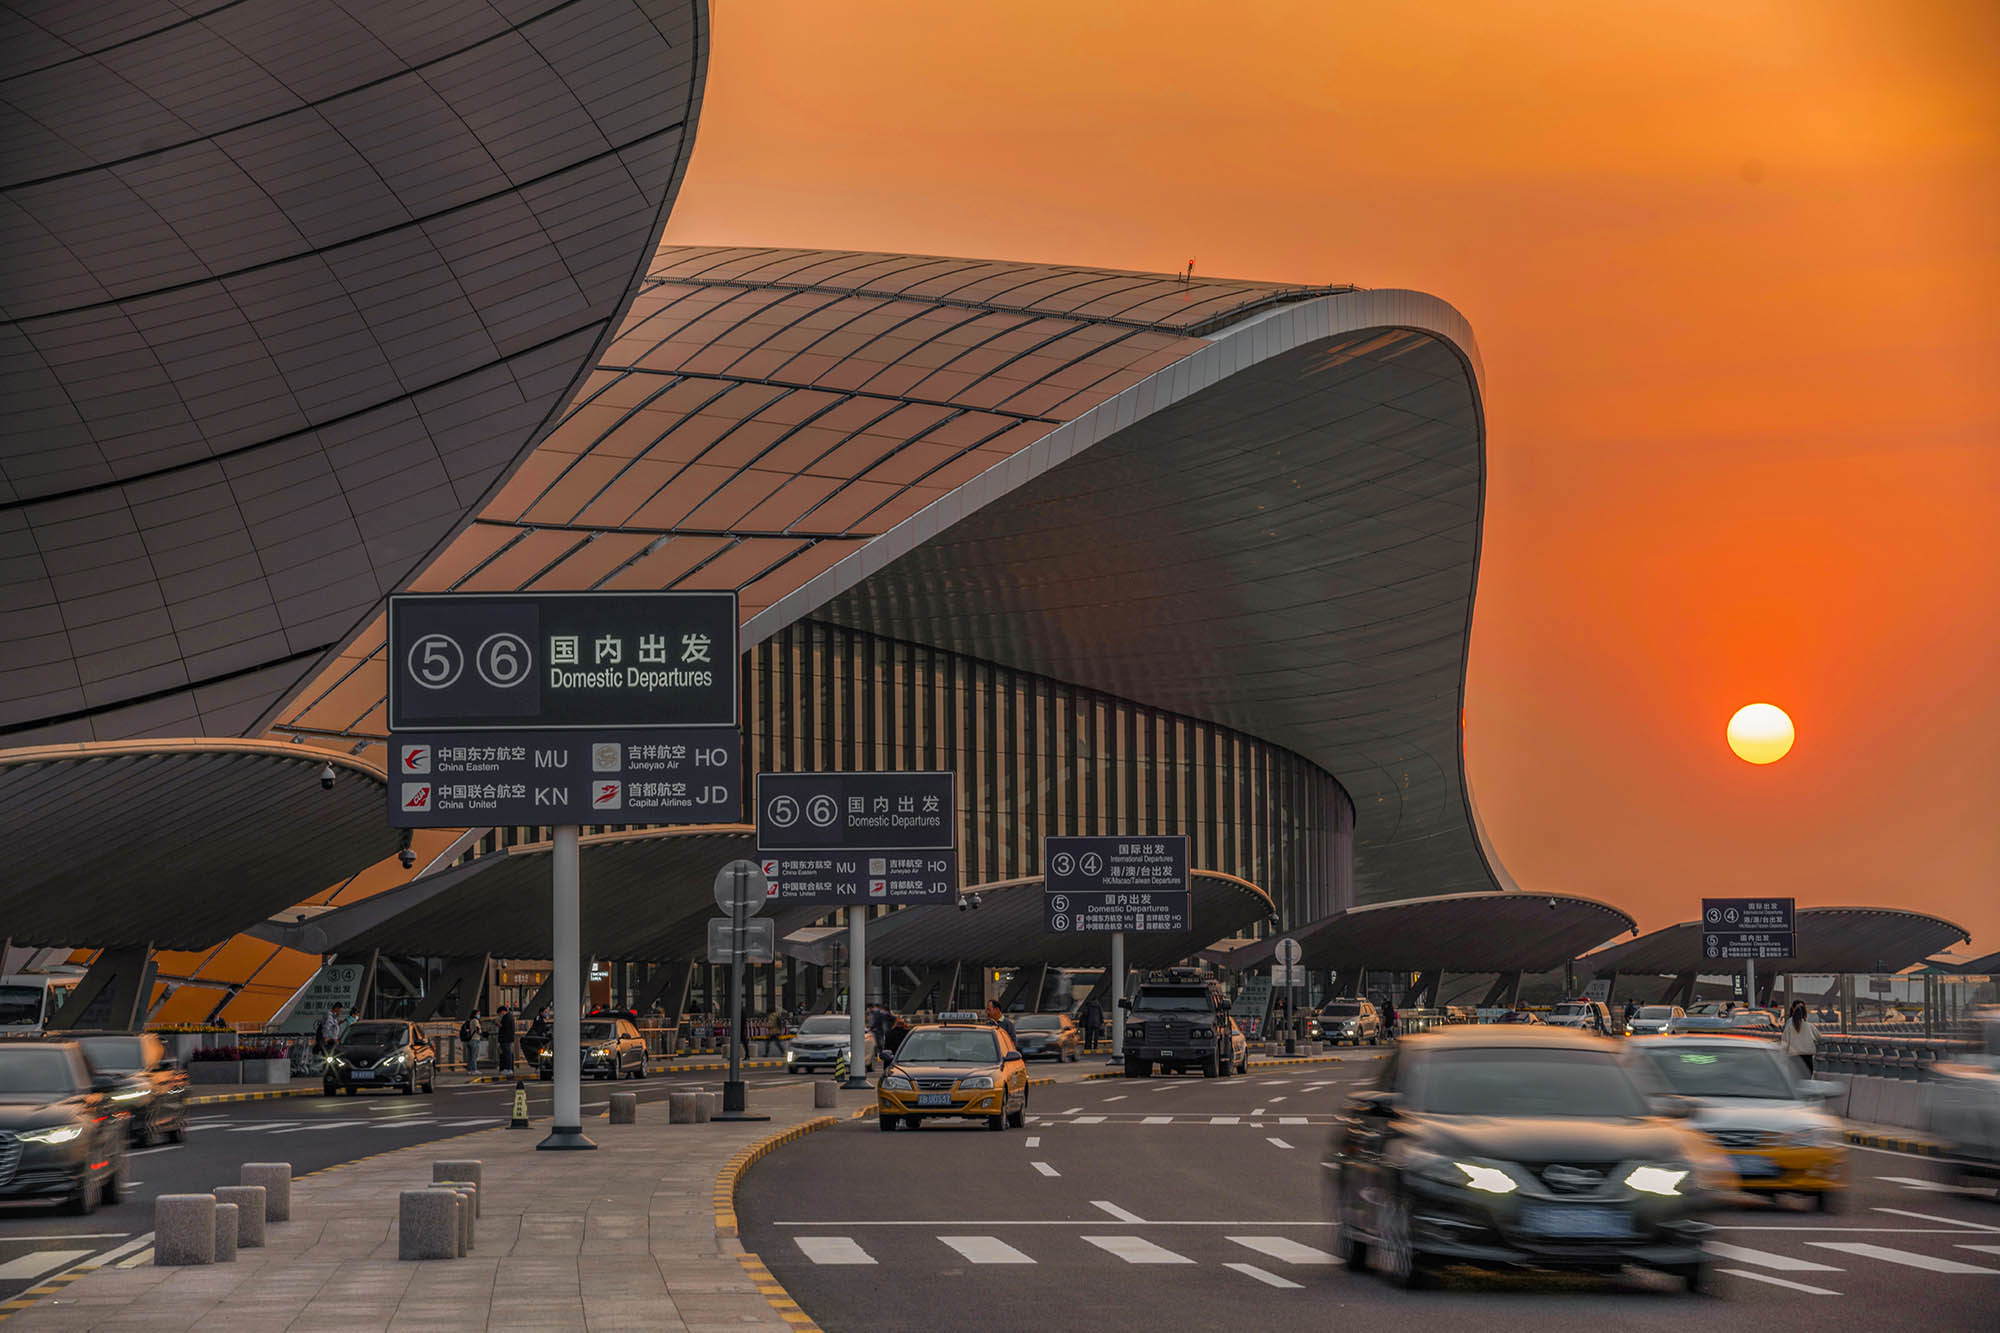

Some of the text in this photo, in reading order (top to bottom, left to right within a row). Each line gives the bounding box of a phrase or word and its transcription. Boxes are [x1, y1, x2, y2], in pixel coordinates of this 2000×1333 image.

[551, 634, 710, 664] 国内出发
[551, 668, 712, 691] Domestic Departures
[439, 746, 525, 761] 中国东方航空
[535, 750, 567, 767] MU
[628, 745, 685, 759] 吉祥航空
[696, 748, 727, 766] HO
[439, 763, 499, 771] China Eastern
[629, 761, 664, 771] Juneyao
[439, 784, 525, 799] 中国联合航空
[628, 782, 686, 796] 首都航空
[696, 786, 727, 804] JD
[535, 788, 567, 805] KN
[629, 798, 692, 808] Capital Airlines
[439, 800, 496, 809] China United
[848, 796, 939, 813] 国内出发
[849, 815, 940, 829] Domestic Departures
[1119, 844, 1164, 855] 国际出发
[837, 862, 855, 873] MU
[928, 861, 946, 872] HO
[837, 884, 856, 894] KN
[928, 883, 947, 893] JD
[1106, 894, 1151, 904] 国内出发
[1126, 905, 1168, 913] Departures
